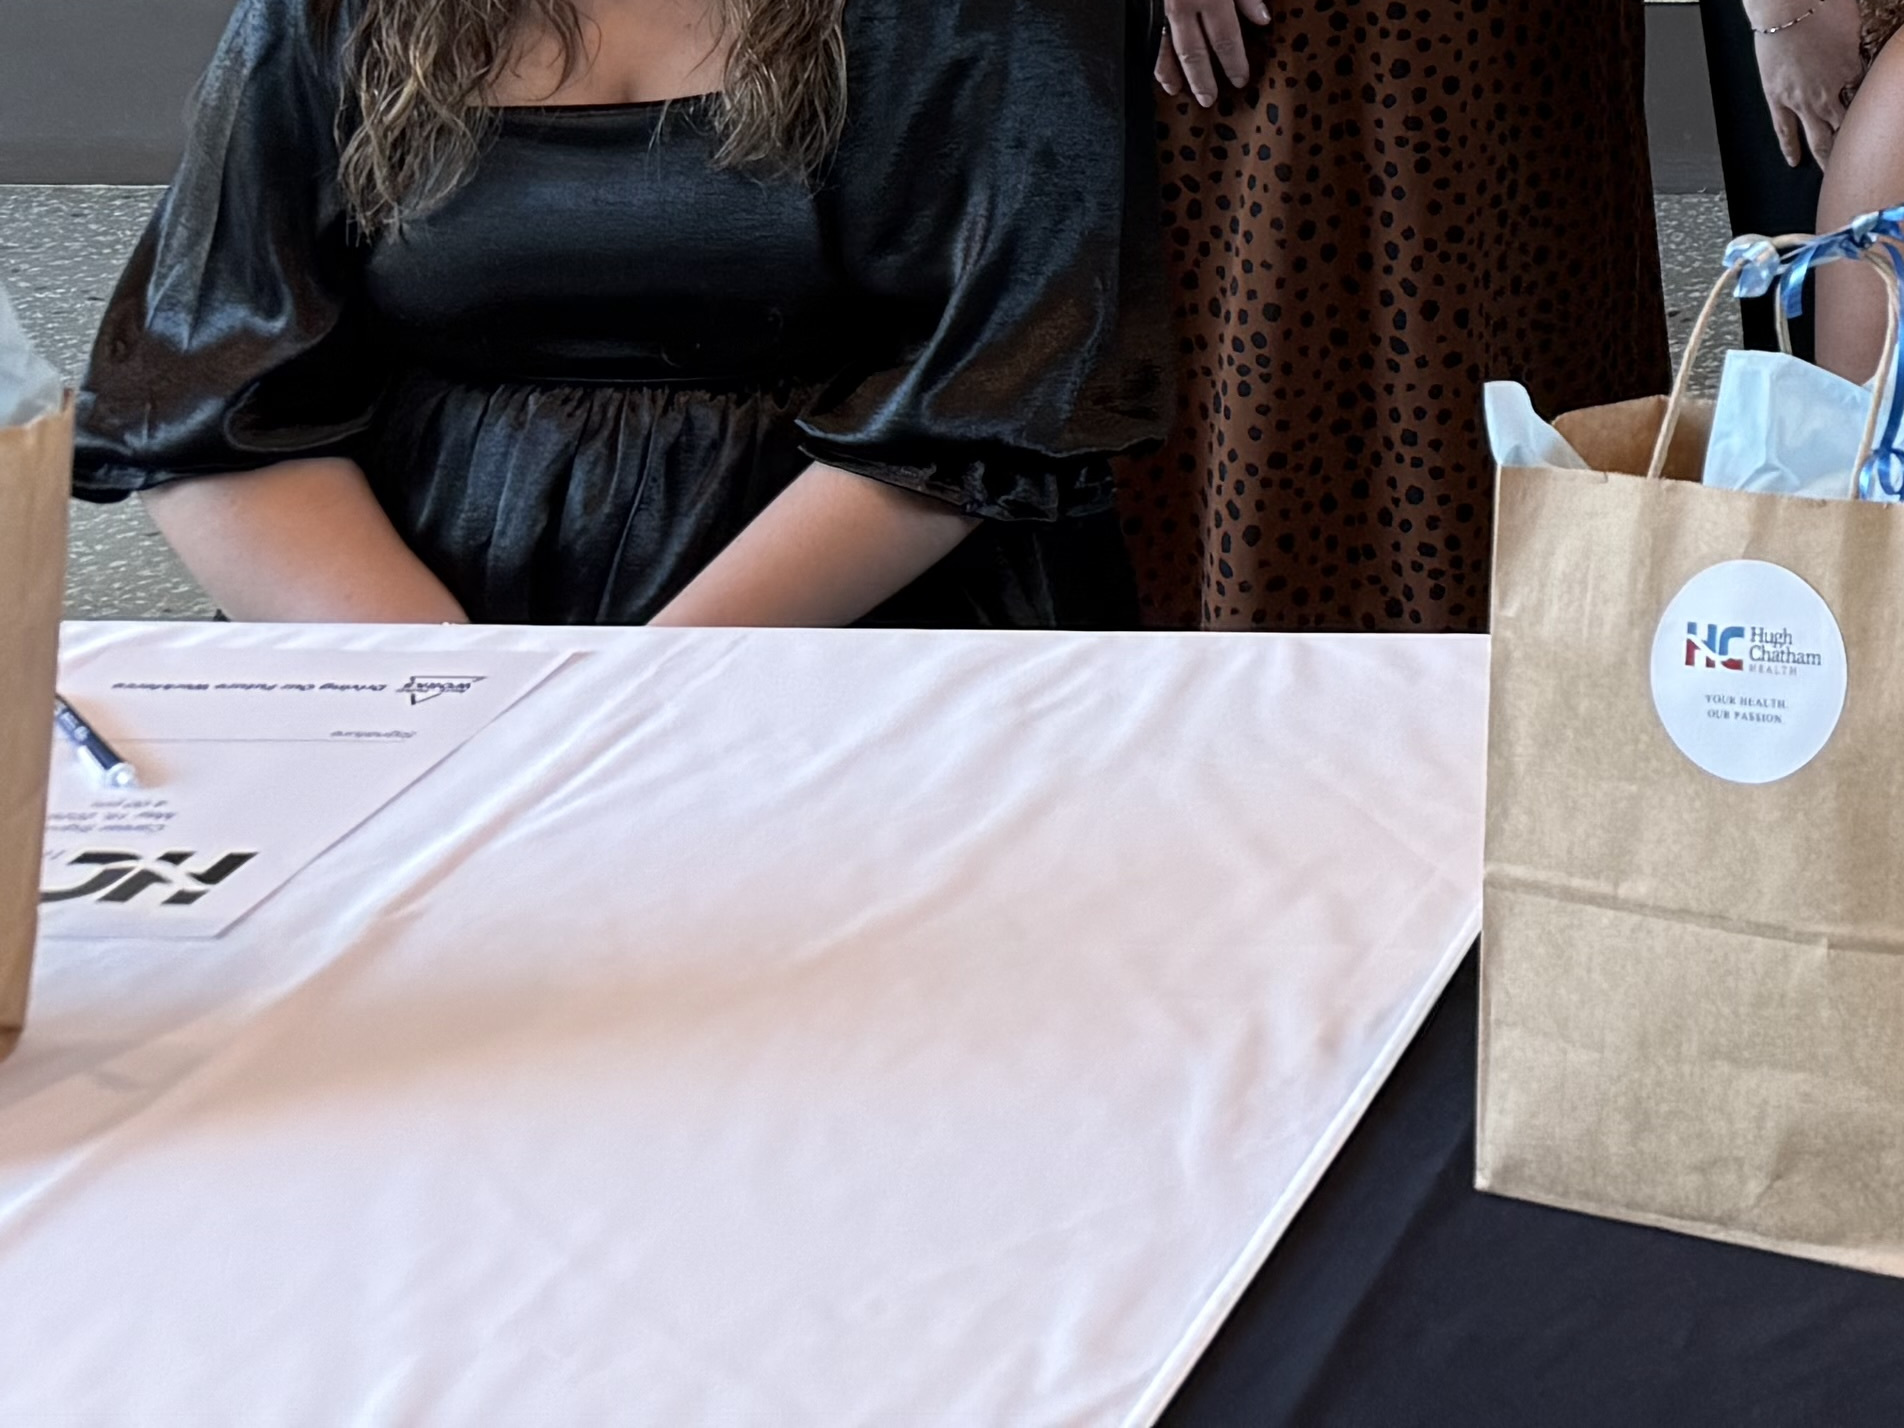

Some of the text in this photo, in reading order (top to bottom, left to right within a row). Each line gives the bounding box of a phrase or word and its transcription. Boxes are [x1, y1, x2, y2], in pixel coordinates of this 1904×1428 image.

[1750, 626, 1793, 649] Hugh
[1685, 621, 1745, 672] HC
[1749, 644, 1822, 666] Chatham
[1749, 663, 1798, 676] HEALTH
[112, 682, 209, 690] Workforce
[214, 682, 277, 690] Future
[280, 683, 315, 691] Our
[319, 682, 387, 691] Driving
[1705, 694, 1736, 705] YOUR
[1707, 708, 1731, 720] OUR
